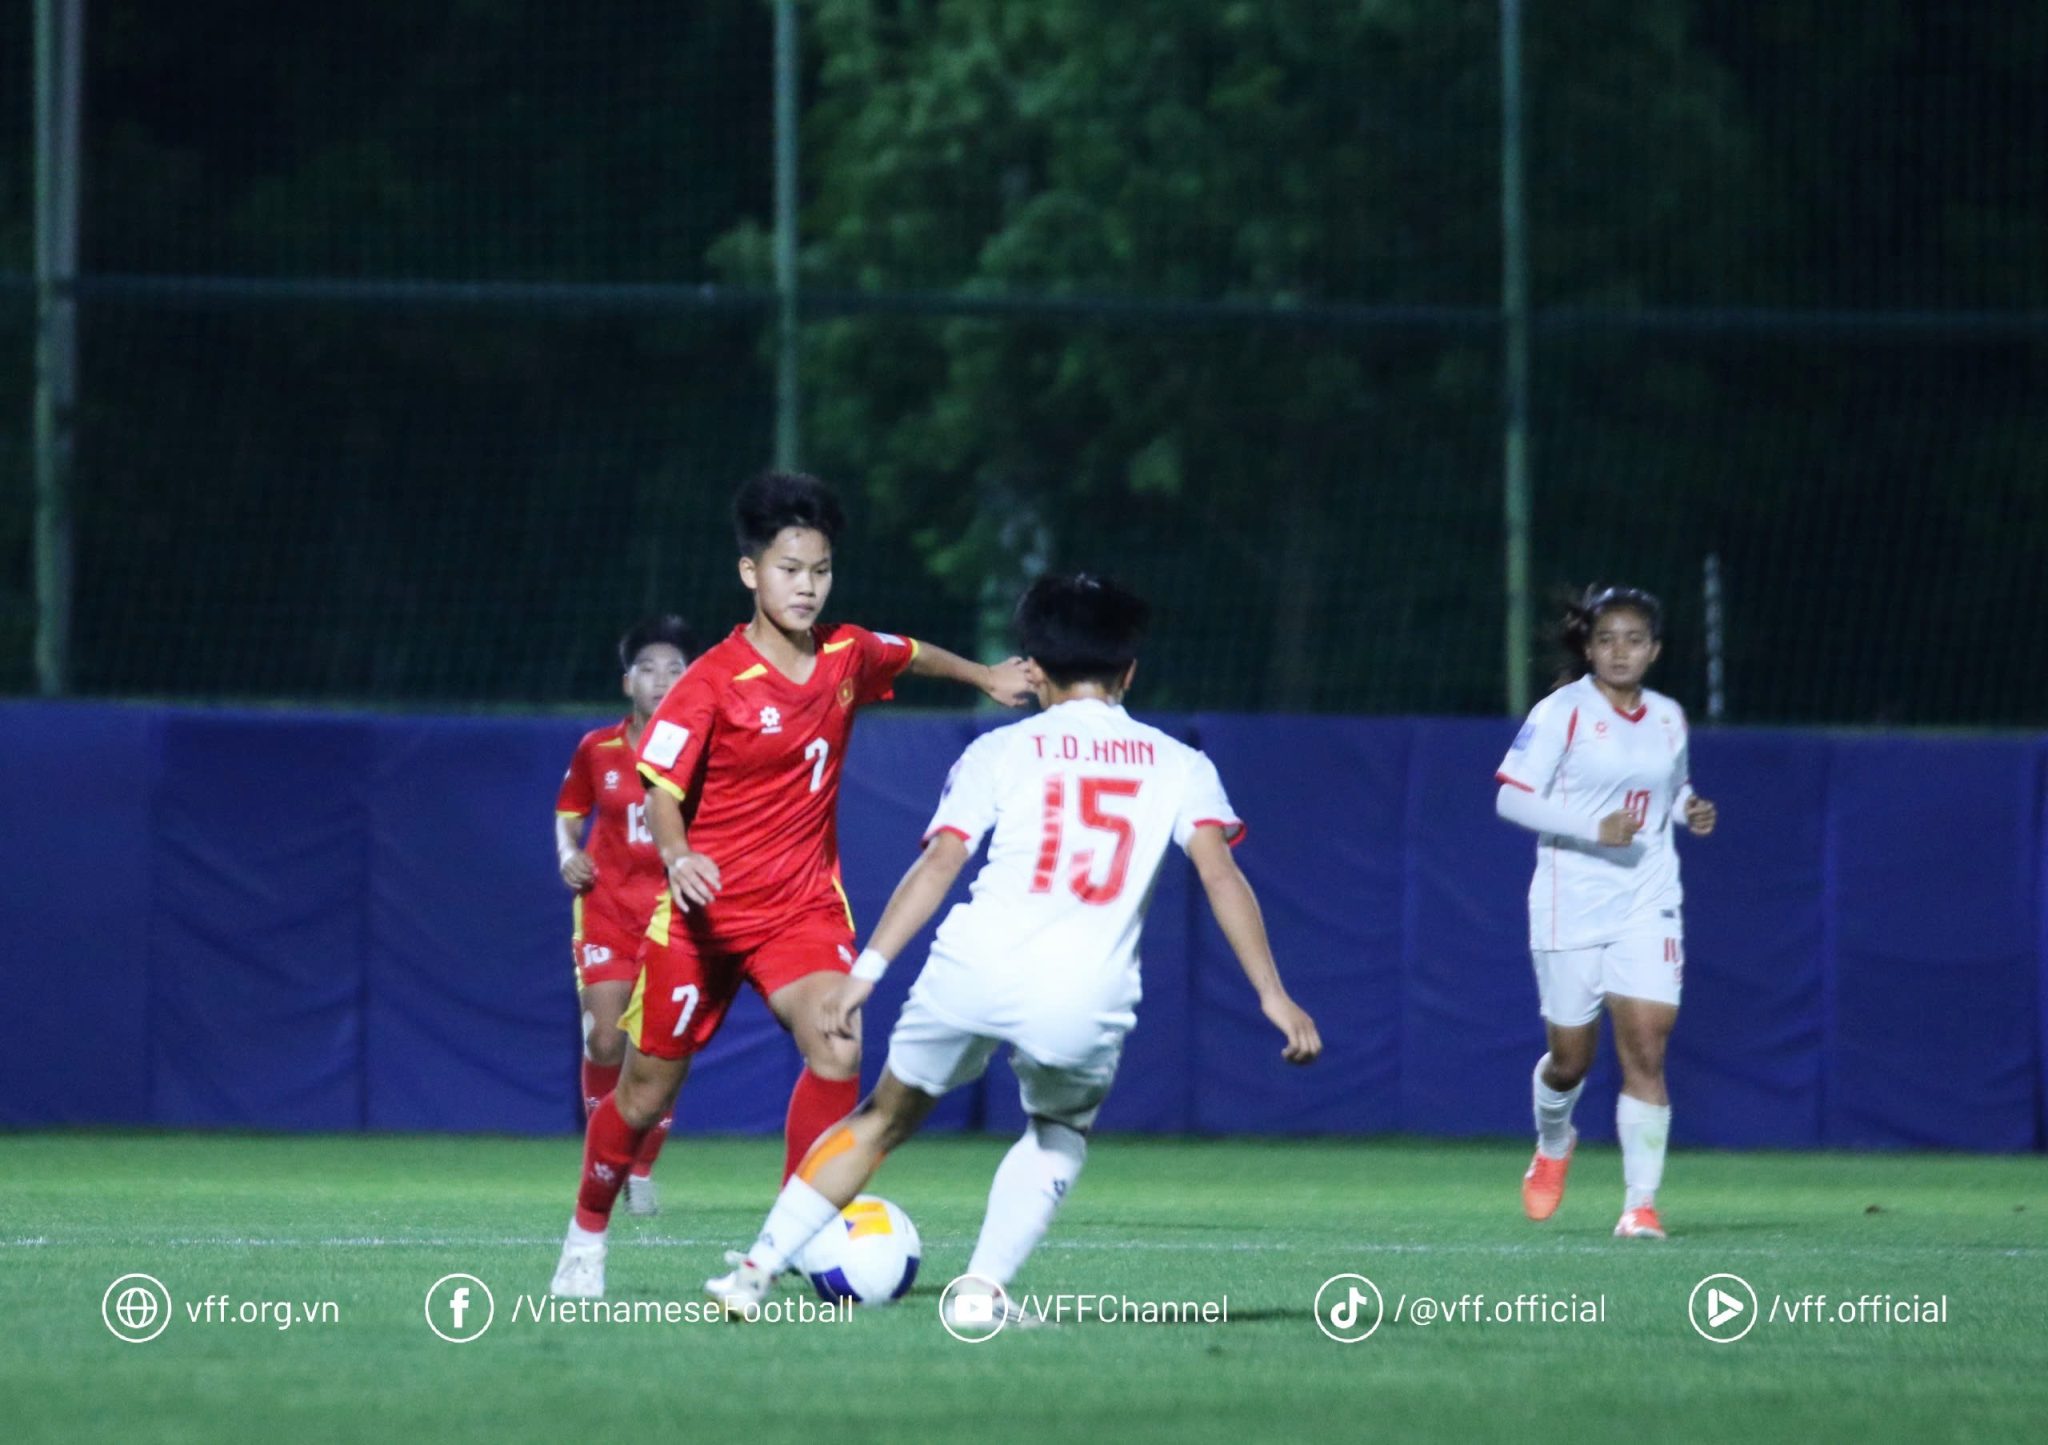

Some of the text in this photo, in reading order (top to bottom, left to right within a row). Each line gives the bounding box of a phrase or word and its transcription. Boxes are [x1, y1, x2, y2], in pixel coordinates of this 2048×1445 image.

[805, 738, 829, 793] 7
[1029, 772, 1143, 906] 15
[672, 983, 699, 1037] 7
